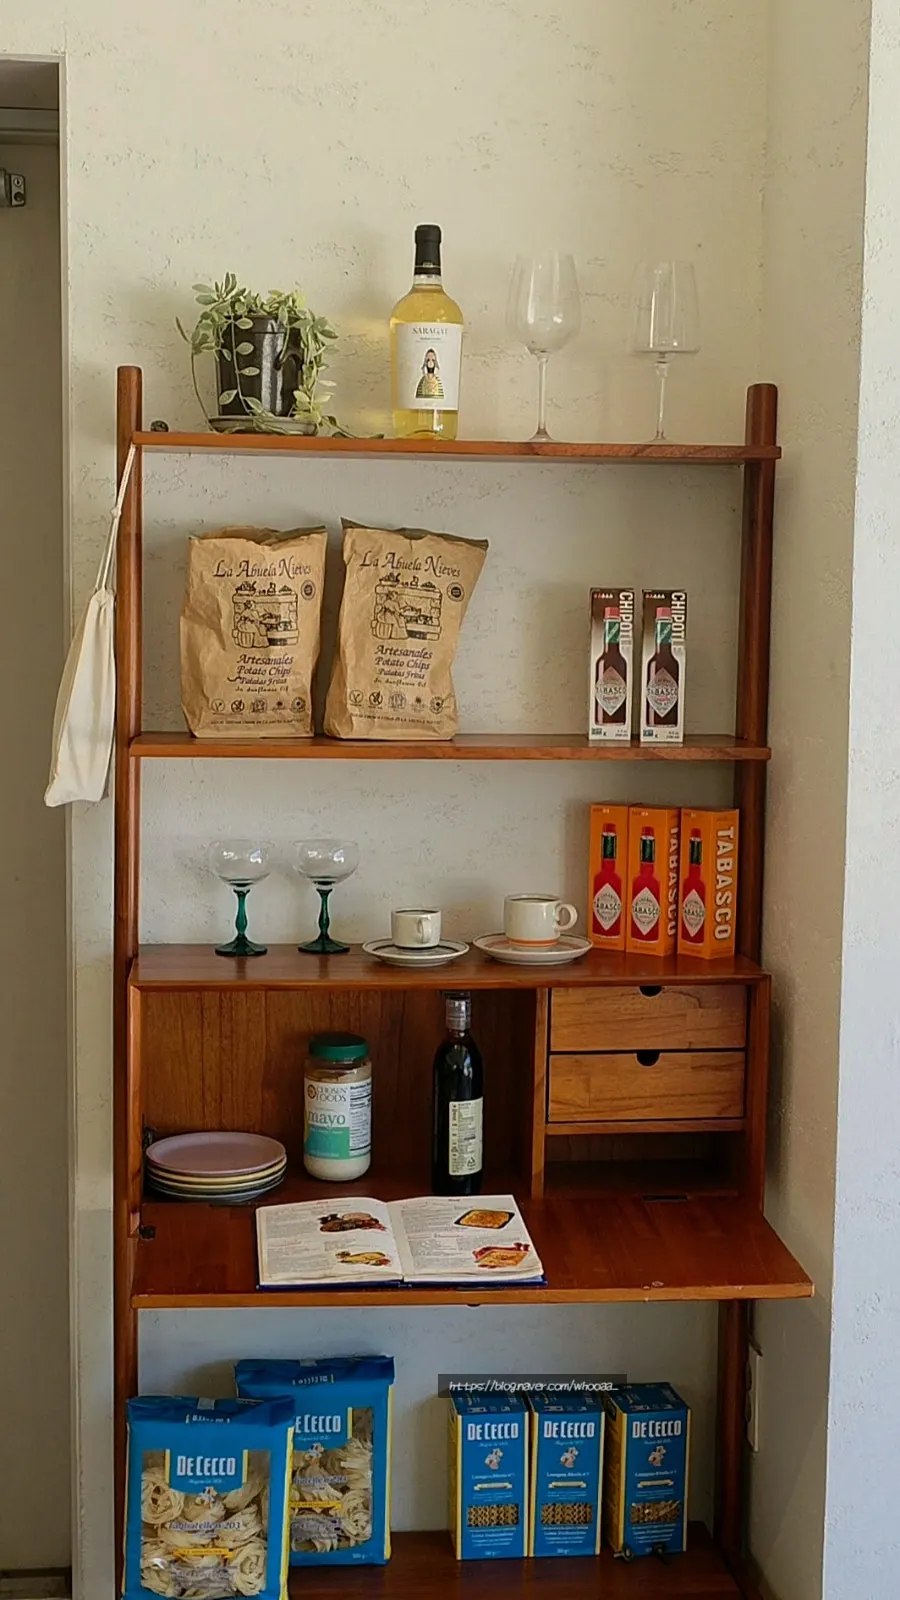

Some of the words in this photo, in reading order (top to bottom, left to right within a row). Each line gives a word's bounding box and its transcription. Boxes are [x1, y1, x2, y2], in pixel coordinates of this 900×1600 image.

[212, 560, 233, 578] La
[236, 560, 277, 579] Abuela
[278, 556, 312, 579] Nieves
[358, 550, 379, 568] La
[381, 551, 422, 572] Abuela
[424, 555, 461, 578] Nieves
[237, 652, 294, 665] Artesanales
[374, 644, 433, 660] Artesanales
[237, 665, 267, 675] Potato
[374, 657, 405, 668] Potato
[406, 658, 431, 672] Chips
[714, 825, 735, 940] TABASCO
[308, 1111, 346, 1127] mayo
